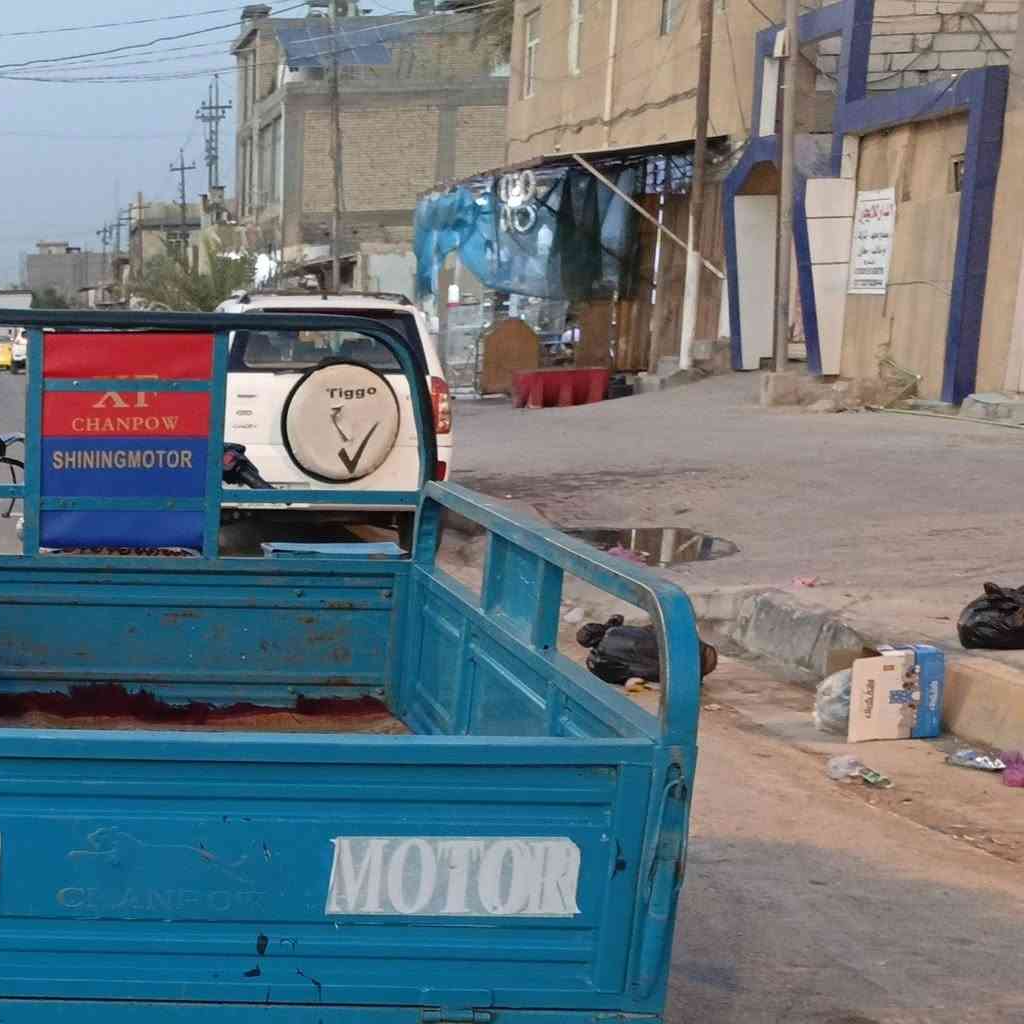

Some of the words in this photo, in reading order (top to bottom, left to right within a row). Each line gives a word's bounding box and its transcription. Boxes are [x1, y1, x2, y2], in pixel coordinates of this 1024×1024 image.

[326, 386, 377, 400] Tiggo
[71, 416, 179, 432] CHANPOW
[52, 450, 193, 469] SHININGMOTOR
[328, 838, 580, 916] MOTOR
